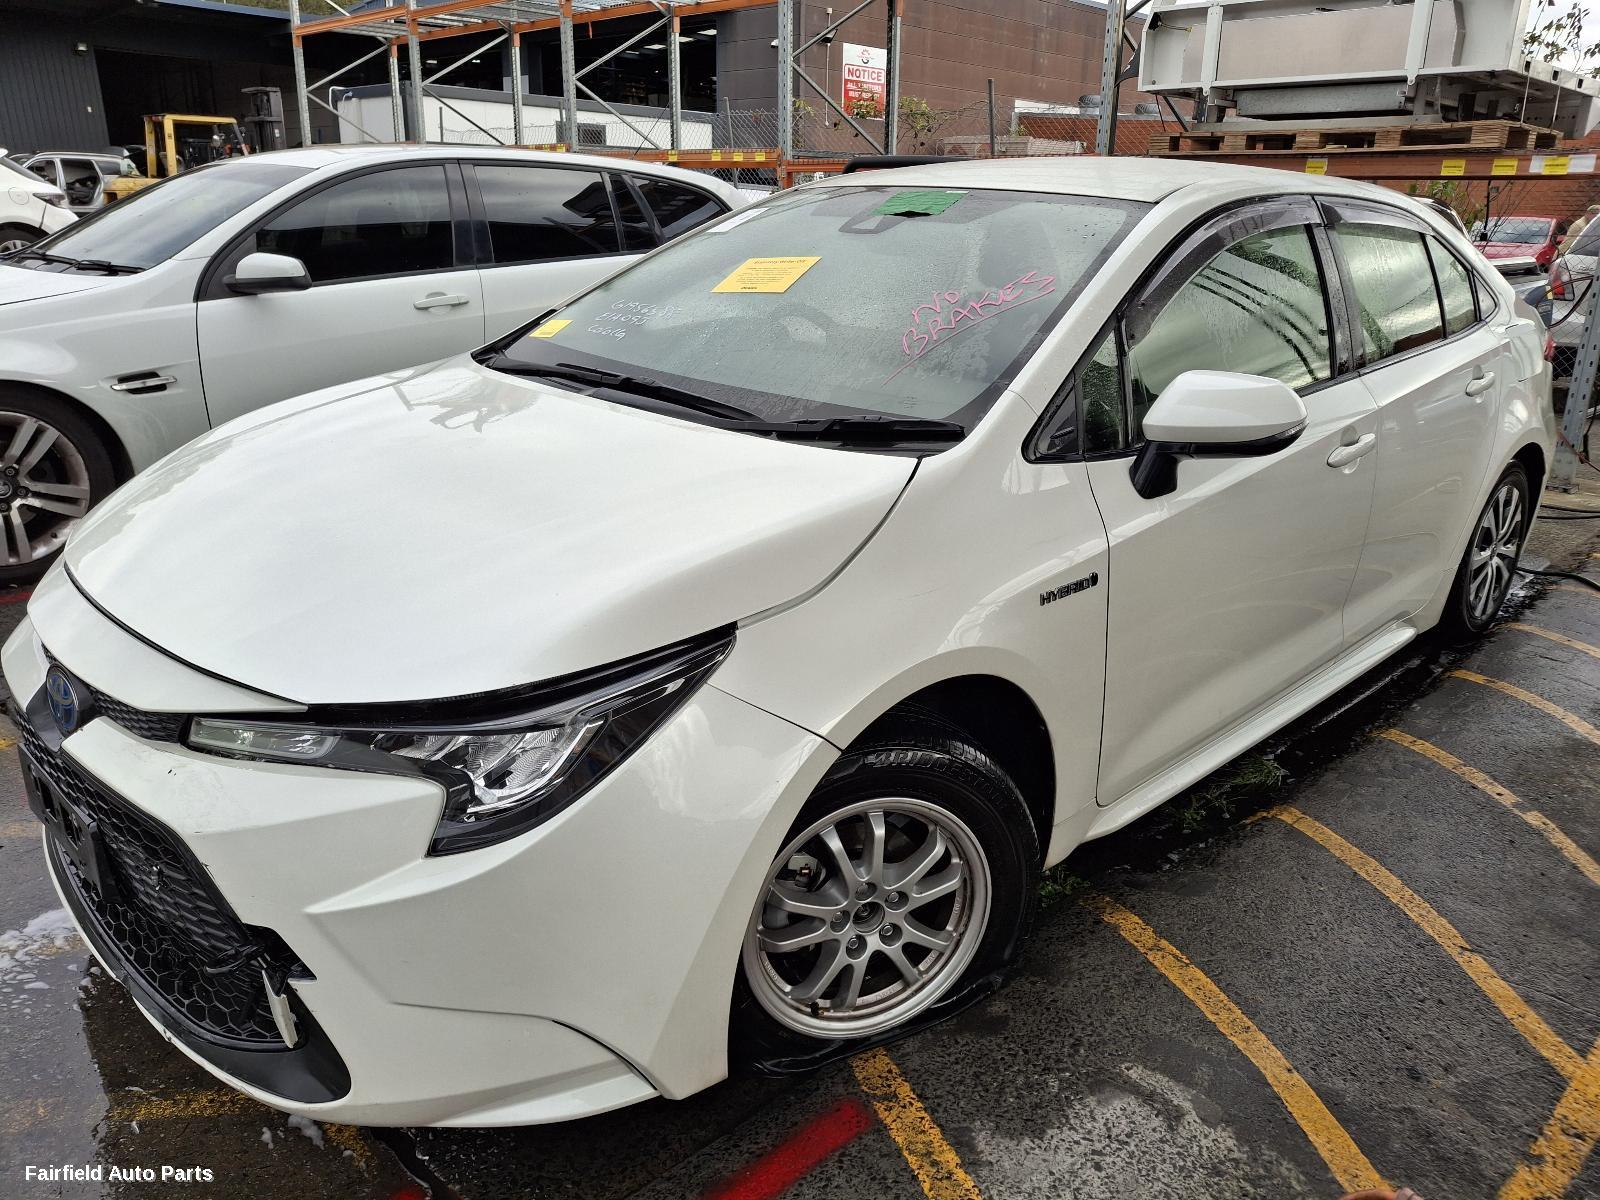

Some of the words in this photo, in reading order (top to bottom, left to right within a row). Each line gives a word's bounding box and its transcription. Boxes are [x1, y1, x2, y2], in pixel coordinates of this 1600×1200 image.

[847, 67, 882, 81] NOTICE
[903, 271, 1056, 357] BRAKES
[912, 291, 960, 324] NO
[1040, 577, 1090, 606] HYBRID
